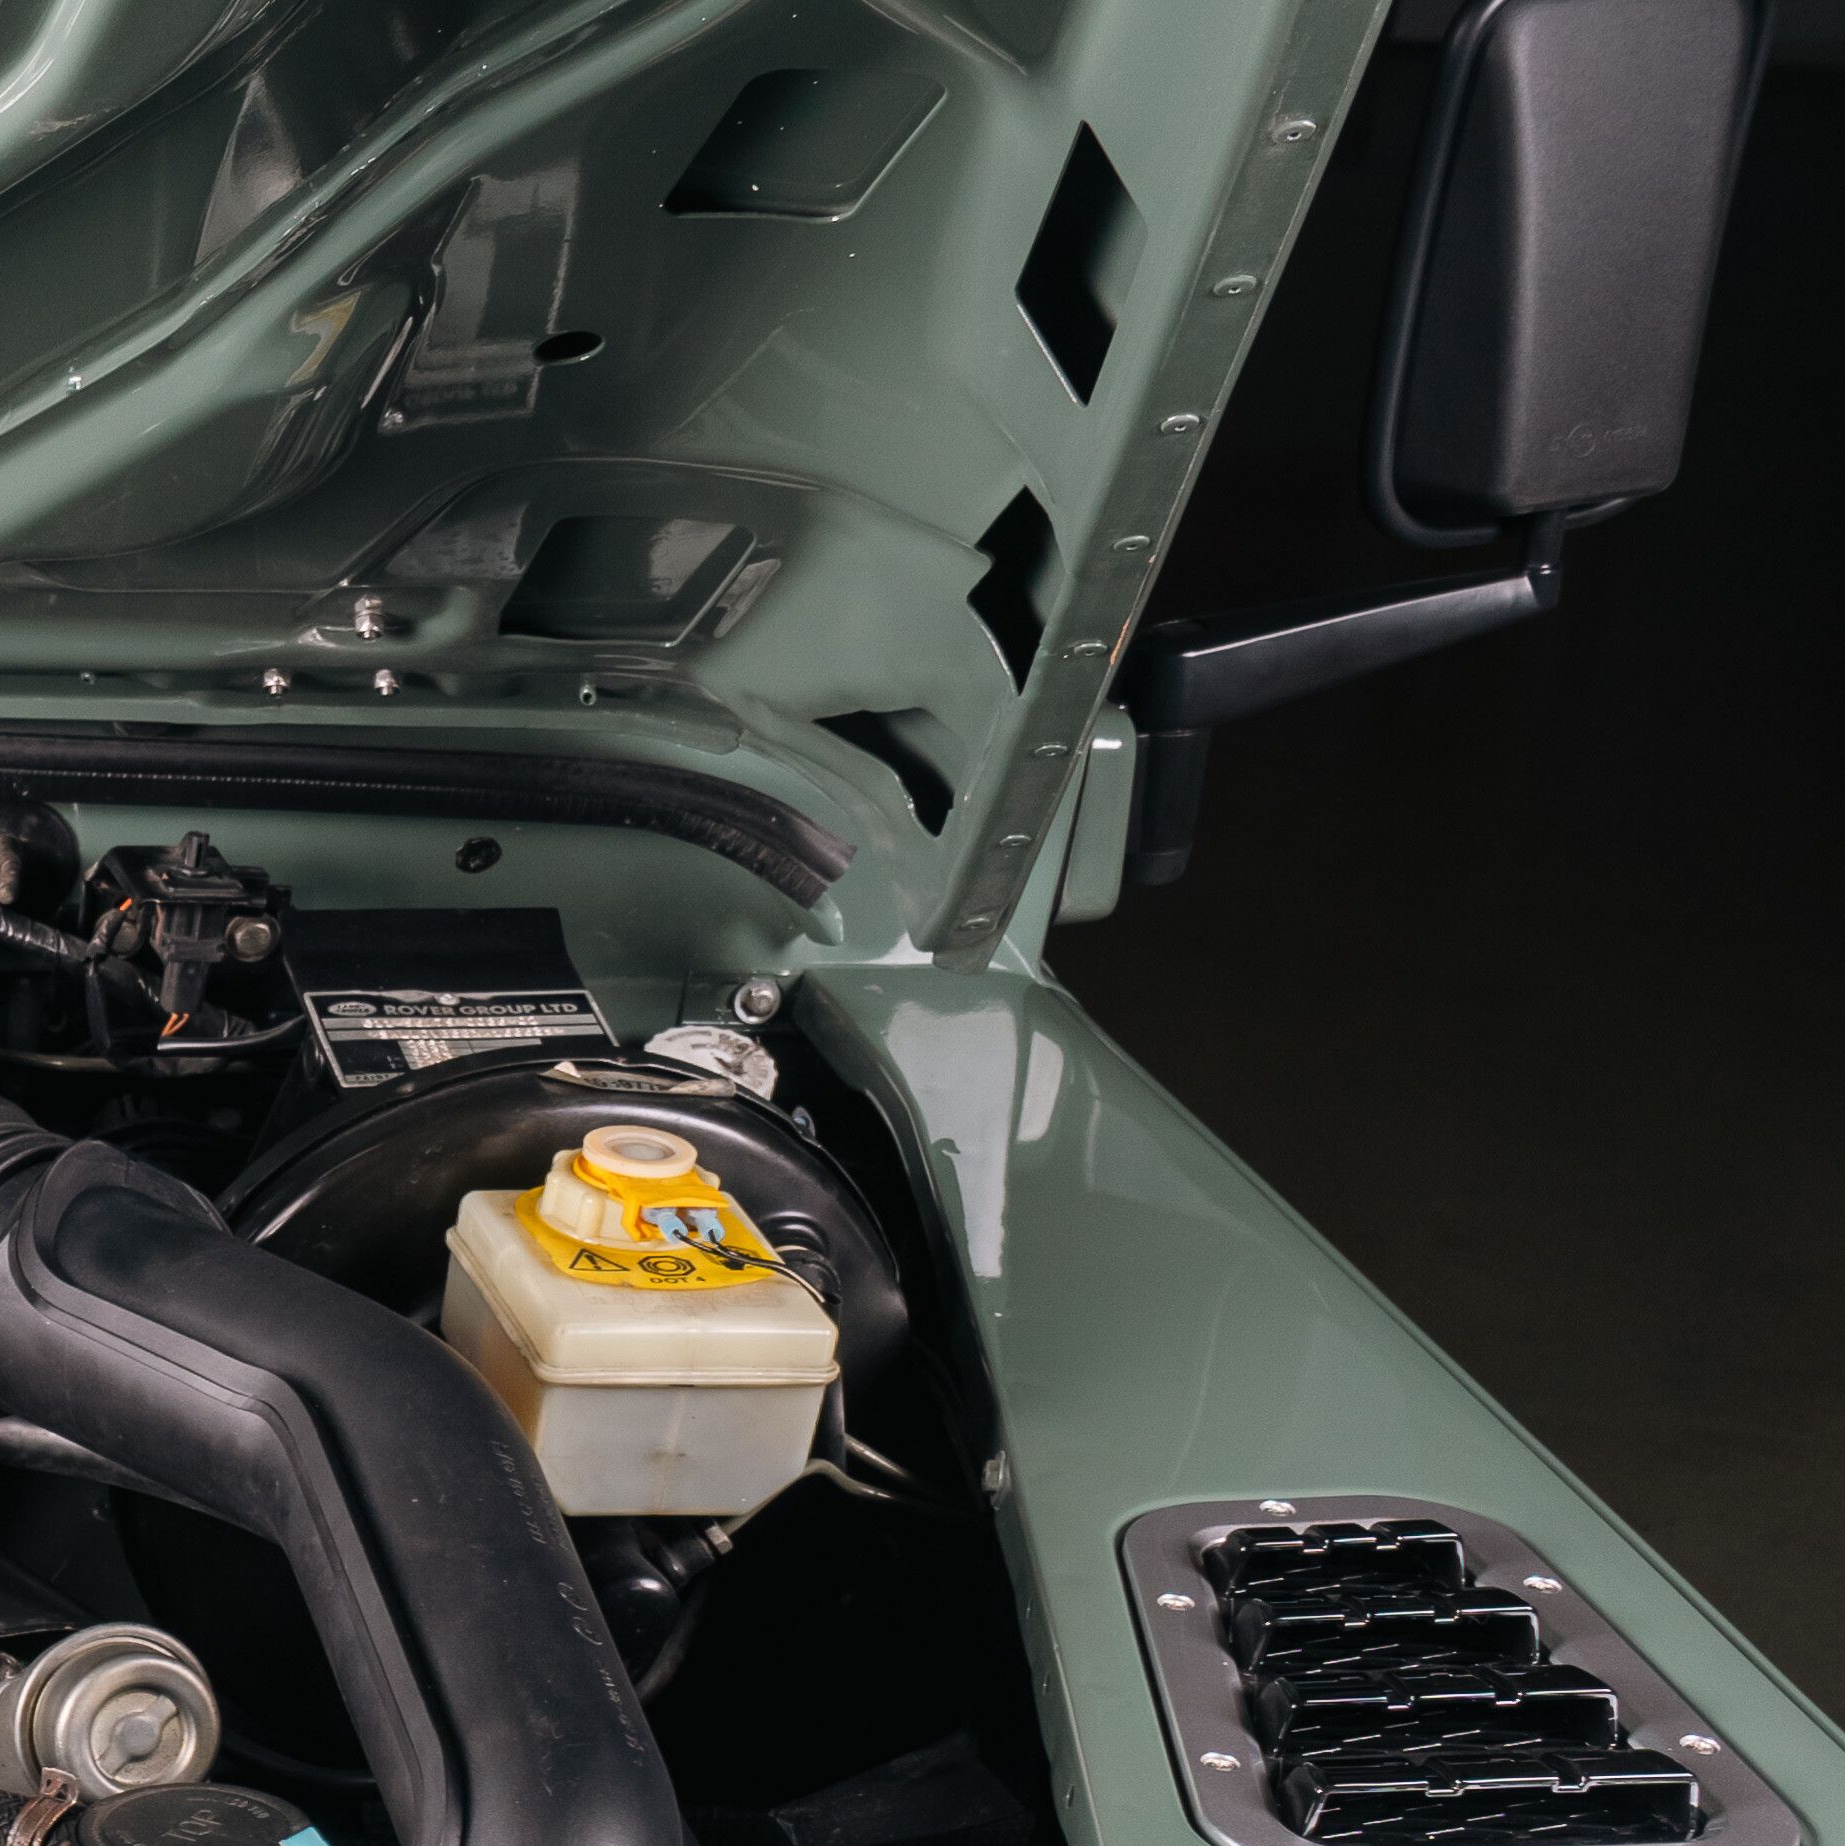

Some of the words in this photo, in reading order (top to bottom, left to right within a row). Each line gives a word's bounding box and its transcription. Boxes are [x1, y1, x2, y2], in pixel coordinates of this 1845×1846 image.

[383, 1004, 457, 1016] ROVER
[459, 1004, 536, 1015] GROUP
[540, 1003, 578, 1014] LTD
[649, 1276, 689, 1284] DOT
[161, 1809, 224, 1843] TOP
